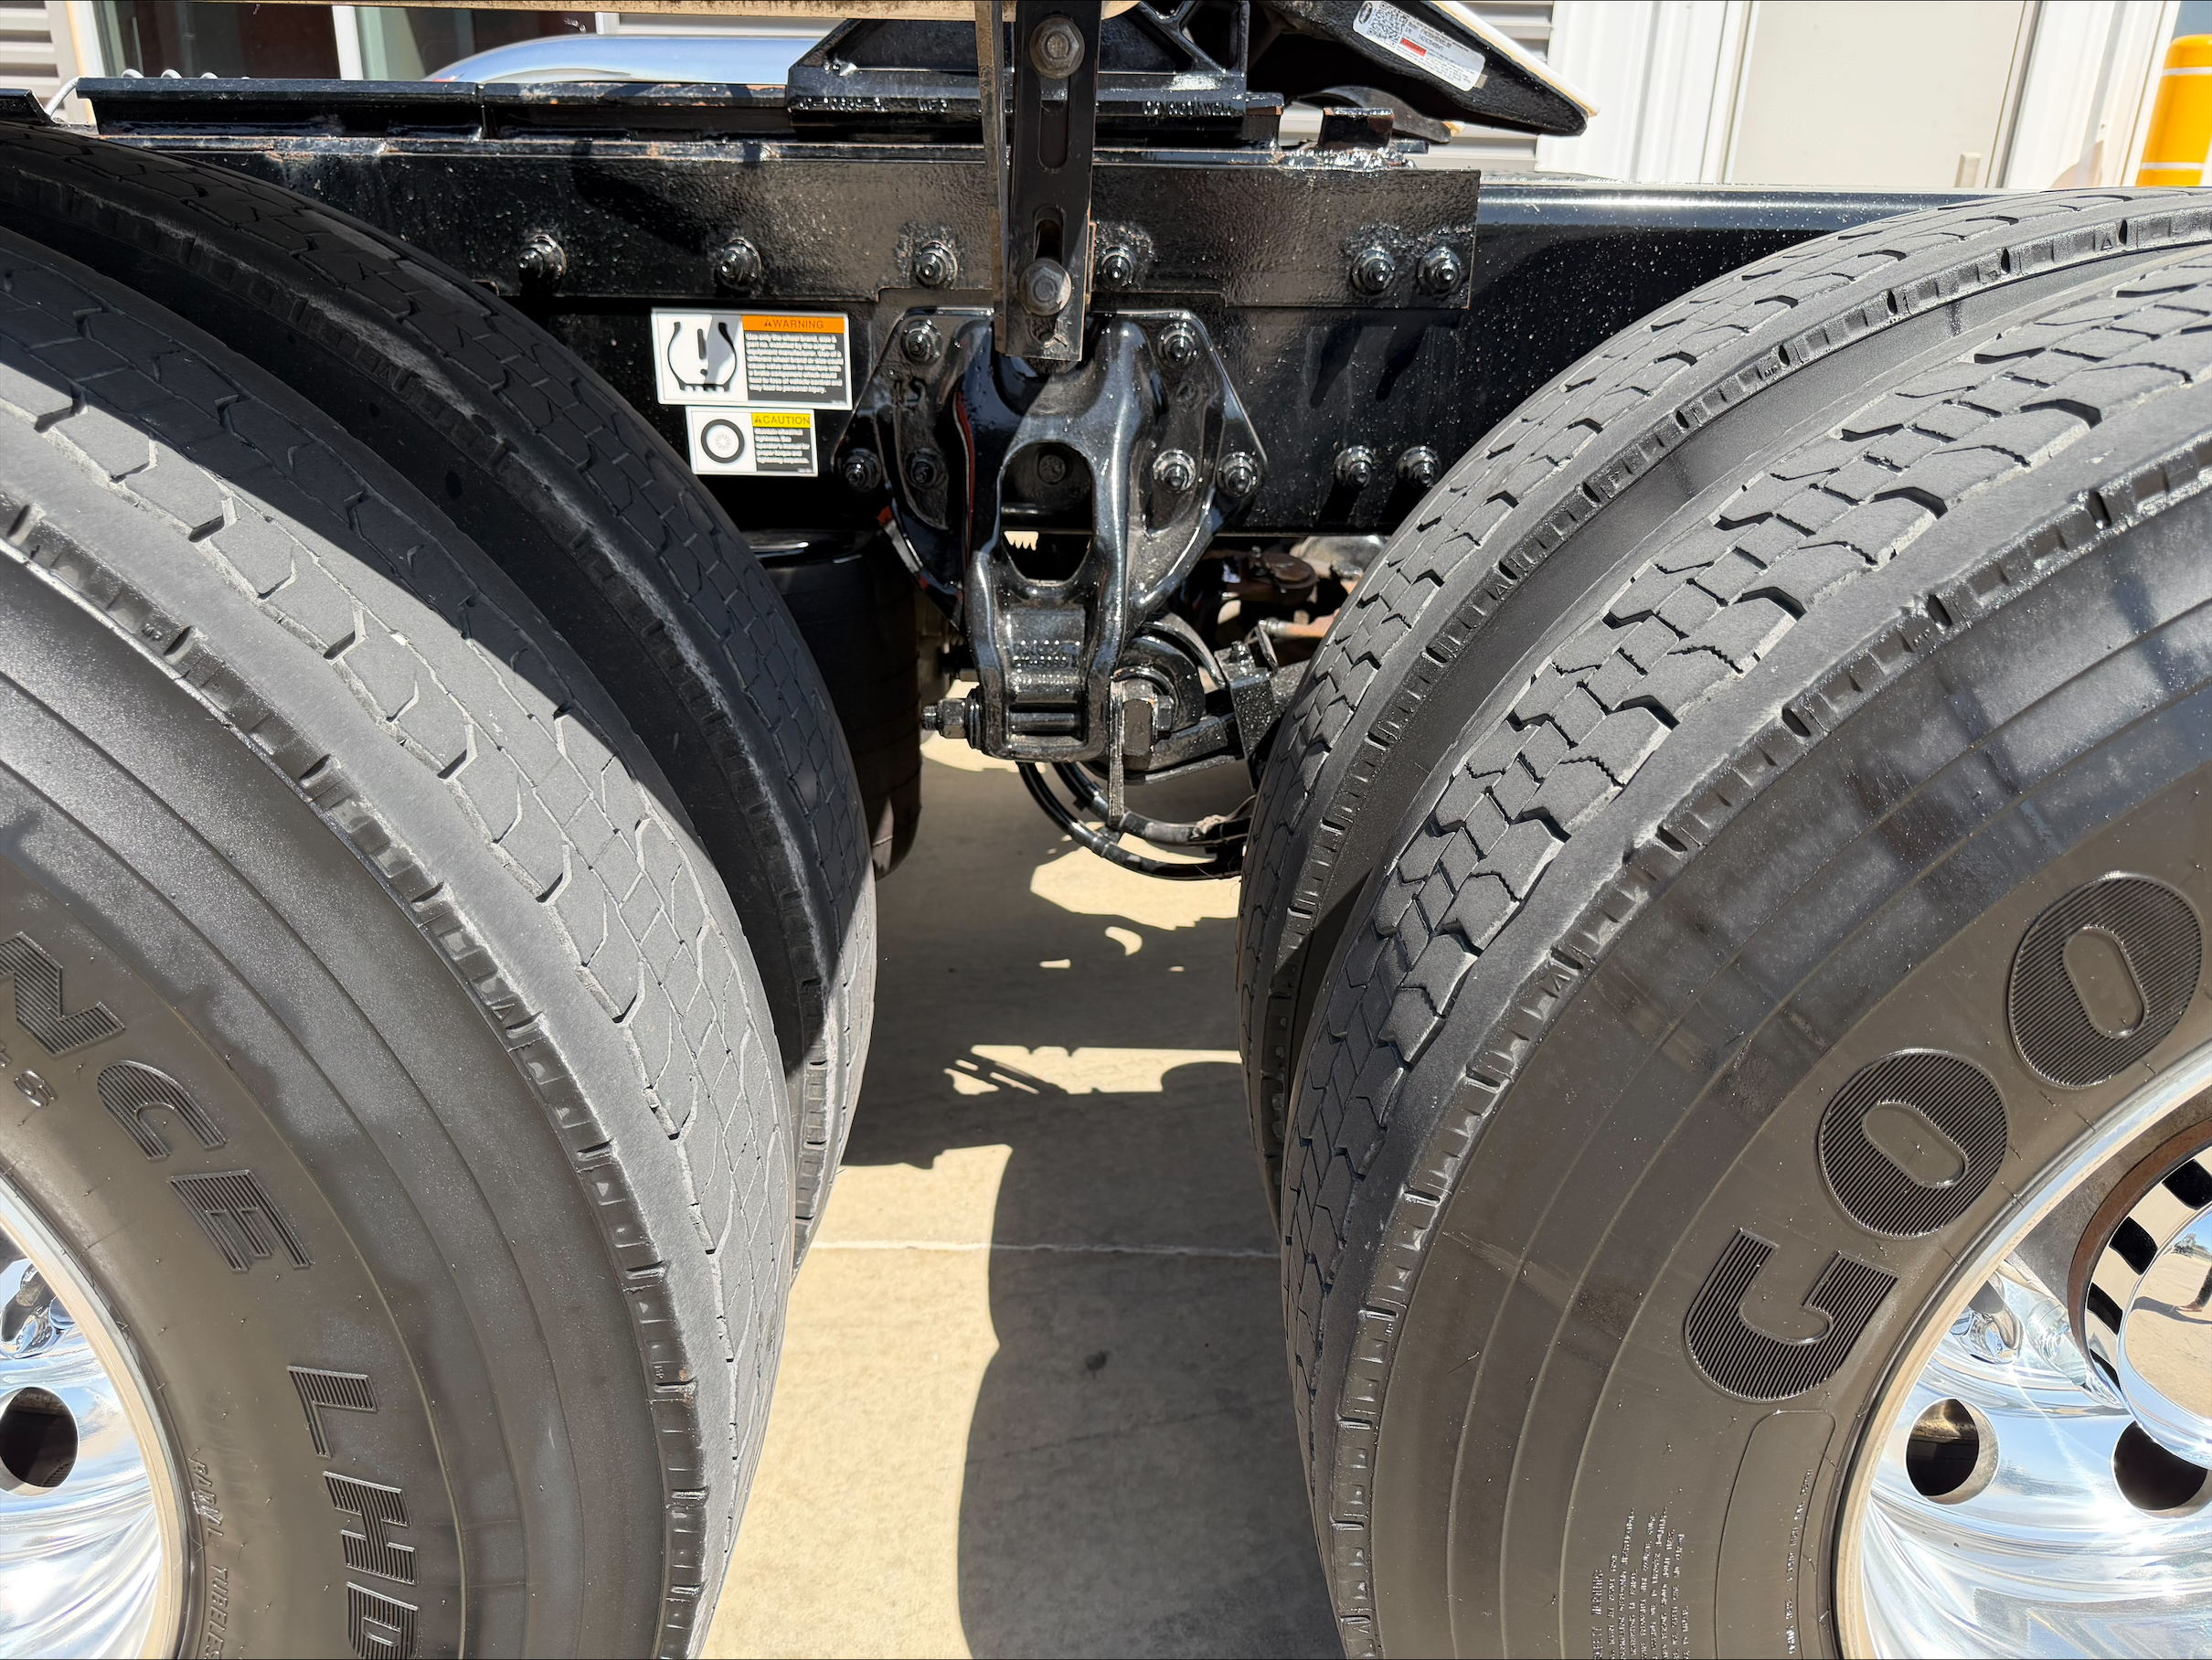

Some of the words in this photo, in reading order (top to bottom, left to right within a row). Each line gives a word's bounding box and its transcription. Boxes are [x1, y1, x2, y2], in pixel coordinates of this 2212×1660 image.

[772, 320, 824, 329] WARNING
[763, 416, 811, 425] CAUTION
[286, 1366, 420, 1658] LHD
